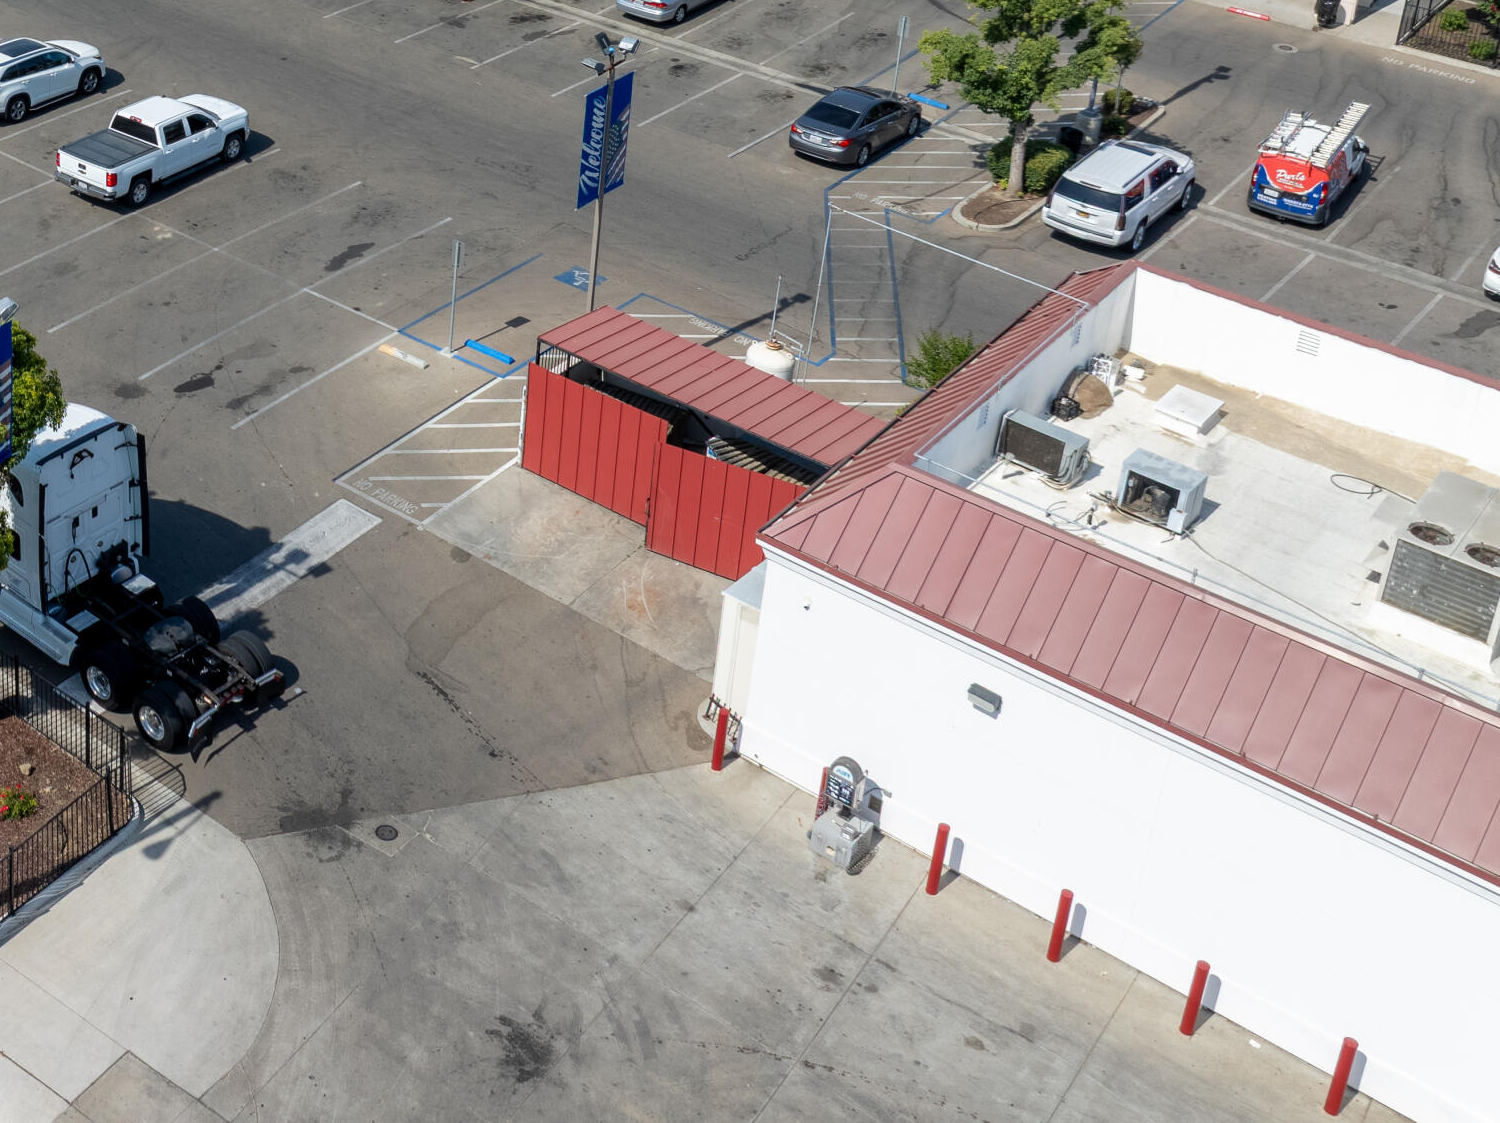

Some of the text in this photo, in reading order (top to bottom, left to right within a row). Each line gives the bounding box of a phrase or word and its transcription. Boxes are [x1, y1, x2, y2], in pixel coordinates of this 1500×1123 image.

[1381, 56, 1476, 84] NO PARKING
[580, 95, 606, 195] Welcome
[688, 317, 751, 346] NO PARKING
